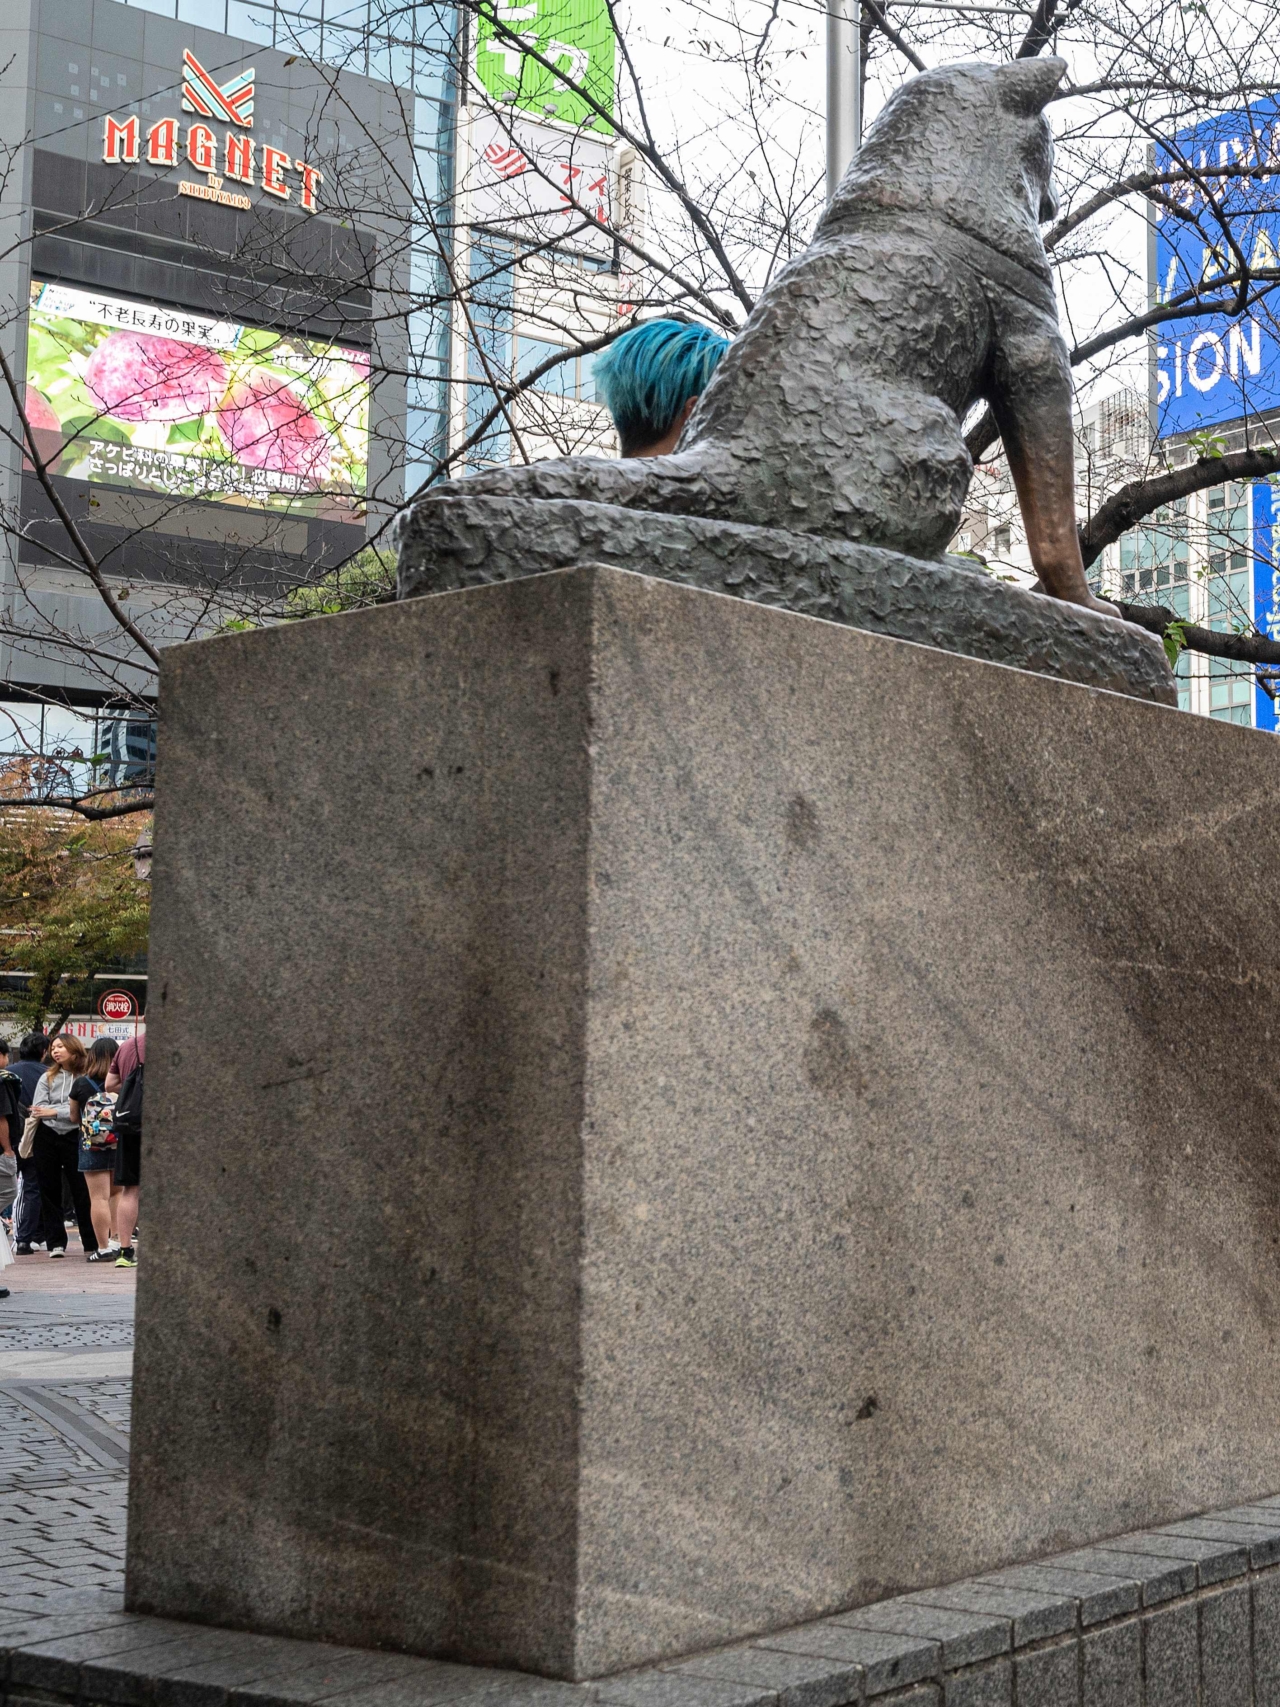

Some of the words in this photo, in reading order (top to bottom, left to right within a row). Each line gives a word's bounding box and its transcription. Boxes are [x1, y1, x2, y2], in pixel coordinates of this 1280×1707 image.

[102, 114, 324, 214] MAGNET
[208, 173, 223, 189] by
[178, 180, 251, 211] SHIBUYA109
[106, 1001, 129, 1012] 消火栓
